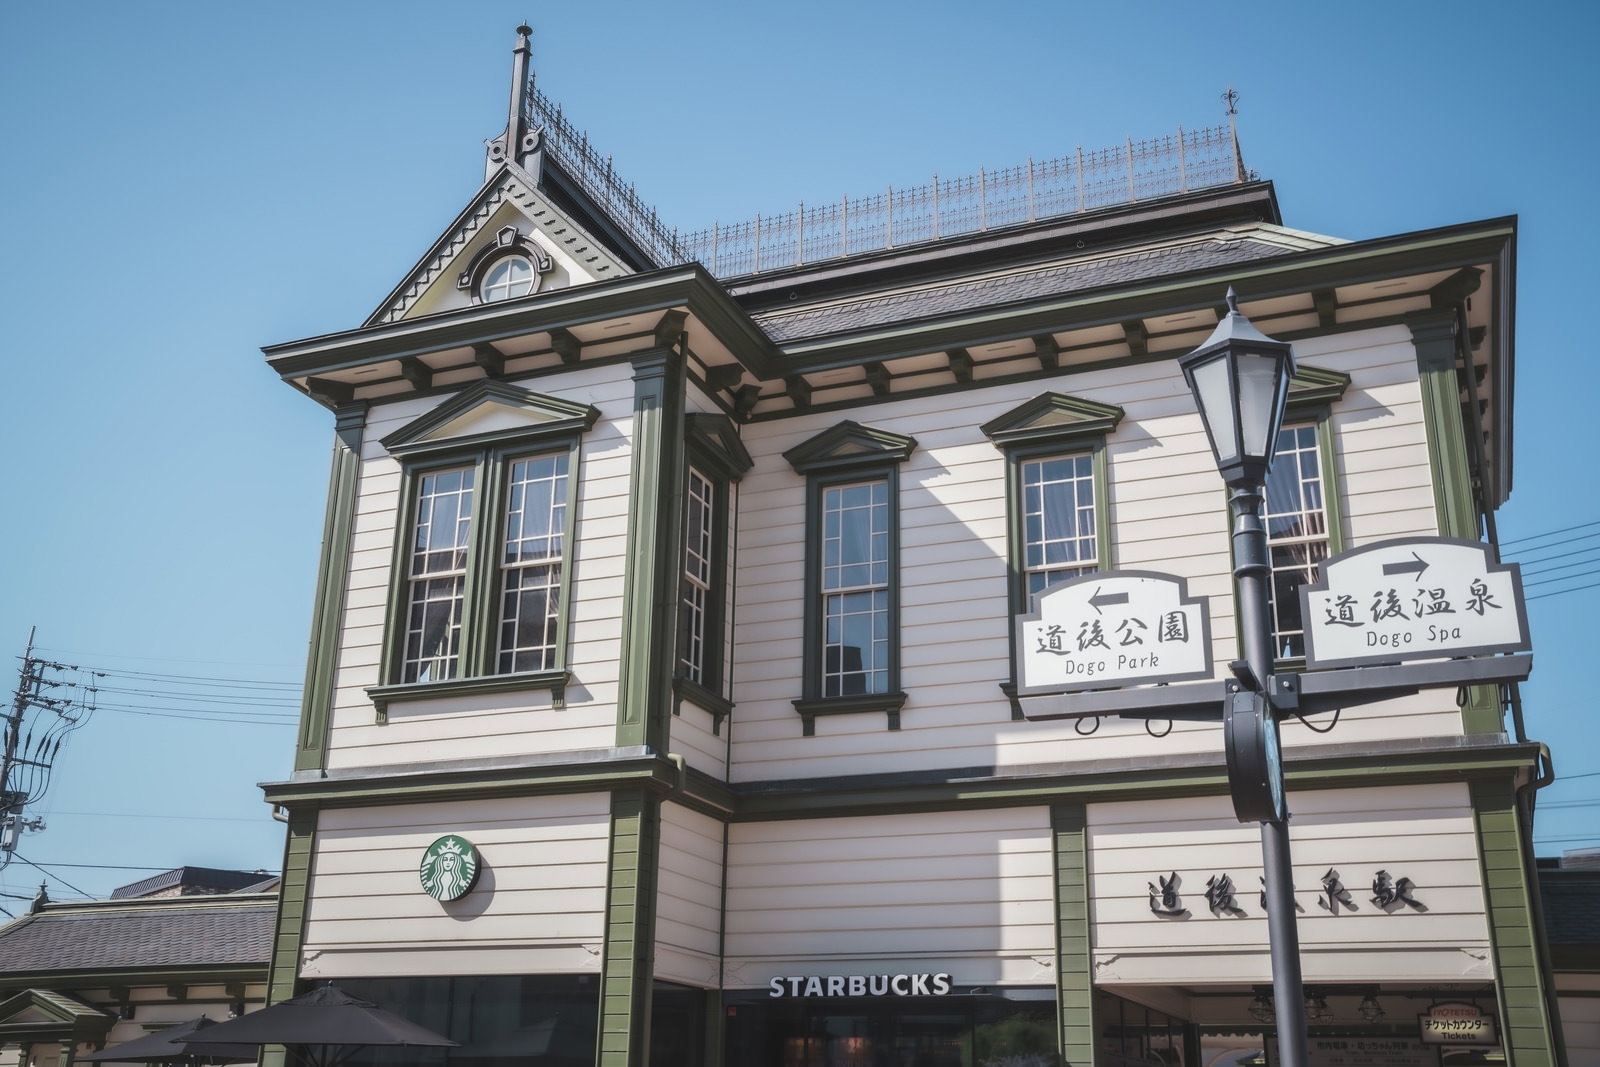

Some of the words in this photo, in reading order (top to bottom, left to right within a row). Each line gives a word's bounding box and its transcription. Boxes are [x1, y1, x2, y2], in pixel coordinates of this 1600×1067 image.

[1324, 578, 1503, 628] 道後温泉
[1036, 610, 1189, 656] 道後公園
[1366, 630, 1412, 647] Dogo
[1427, 624, 1462, 643] Spa
[1065, 659, 1106, 676] Dogo
[1118, 651, 1159, 670] Park
[1148, 867, 1423, 917] 道後泉駅
[768, 973, 953, 998] STARBUCKS
[1424, 1019, 1490, 1031] チケットカウンター
[1441, 1031, 1477, 1041] Tickets
